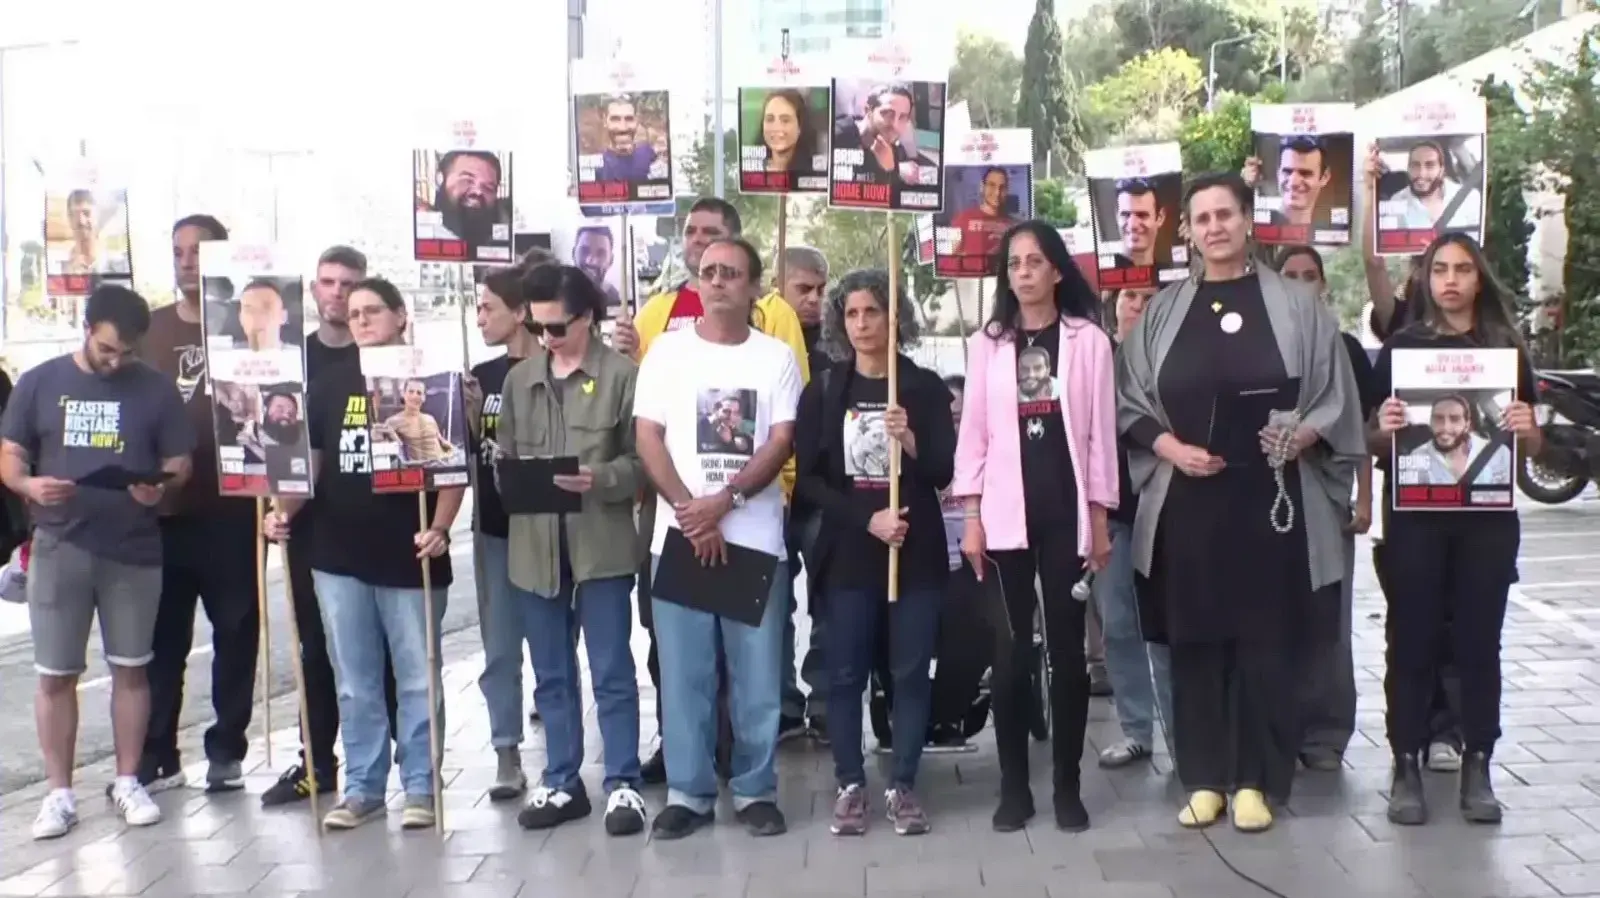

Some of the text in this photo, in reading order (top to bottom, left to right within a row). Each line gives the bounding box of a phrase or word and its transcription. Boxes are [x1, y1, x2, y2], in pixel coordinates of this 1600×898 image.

[834, 148, 864, 165] BRING
[833, 183, 861, 200] HOME
[863, 183, 891, 200] NOW!
[65, 400, 120, 414] CEASEFIRE
[65, 415, 120, 432] HOSTAGE
[1398, 456, 1430, 470] BRING
